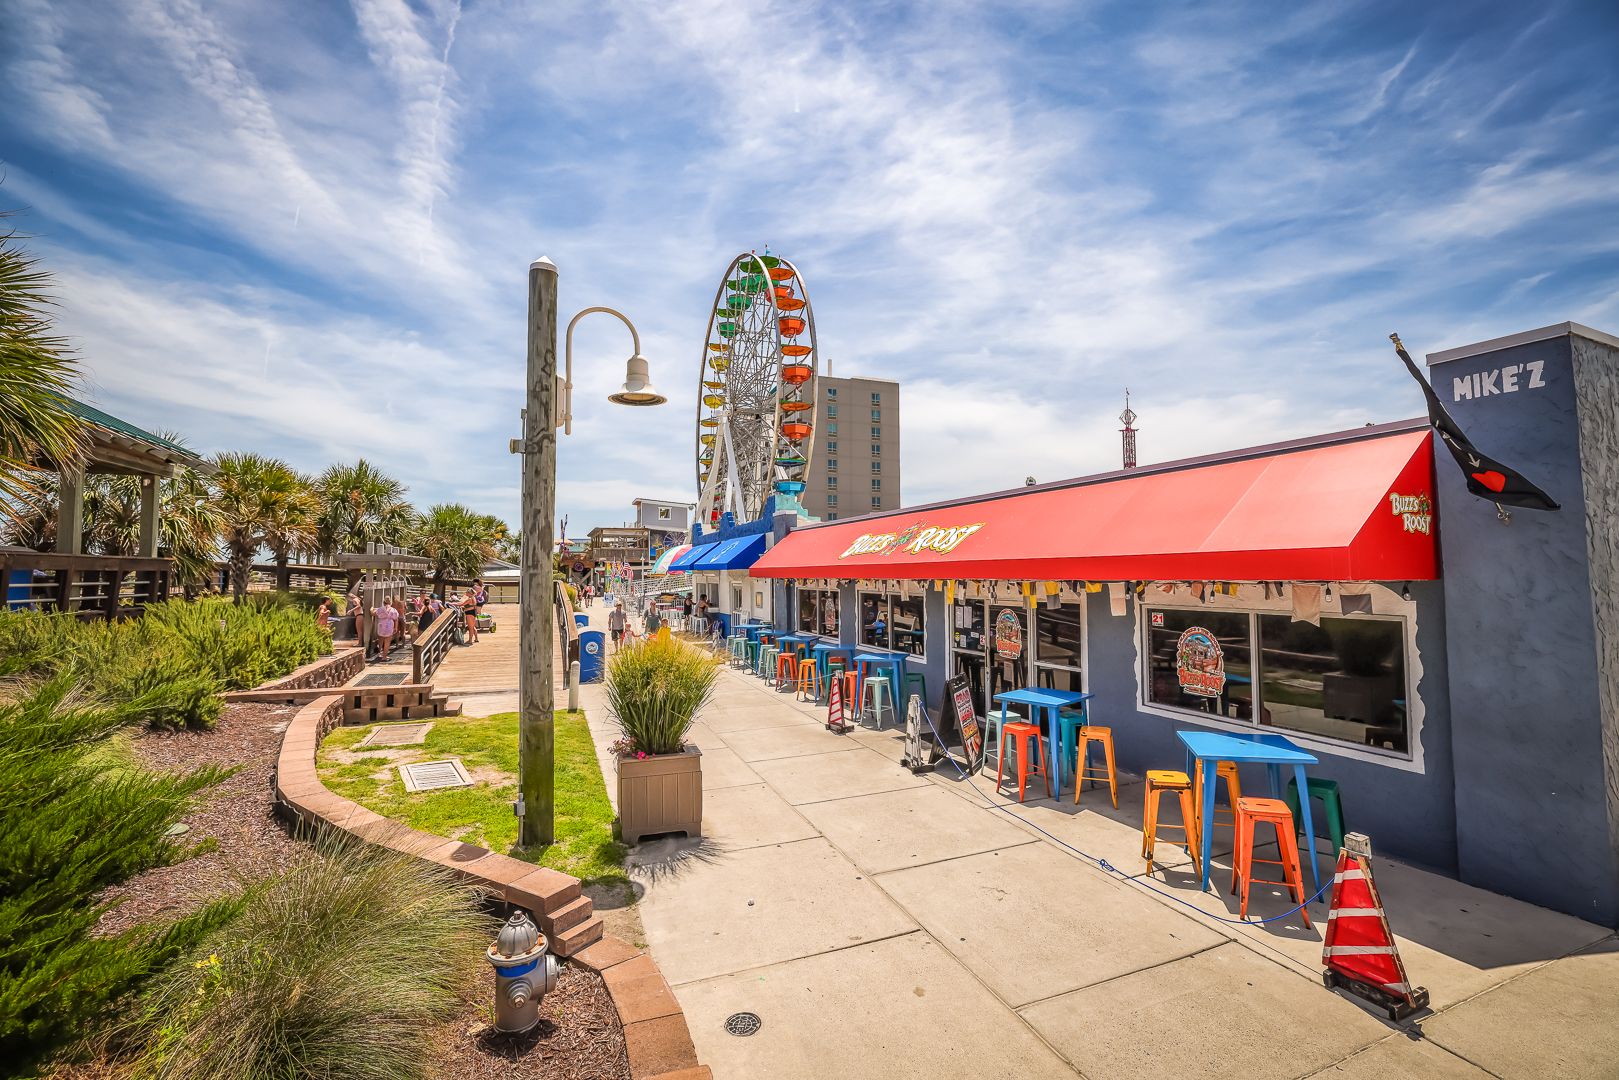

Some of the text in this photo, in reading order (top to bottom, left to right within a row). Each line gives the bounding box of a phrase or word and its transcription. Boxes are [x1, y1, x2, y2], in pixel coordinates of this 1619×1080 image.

[1453, 360, 1546, 402] MIKE'Z
[1402, 512, 1431, 535] ROOST
[902, 523, 987, 555] ROOST
[1152, 614, 1163, 623] 21
